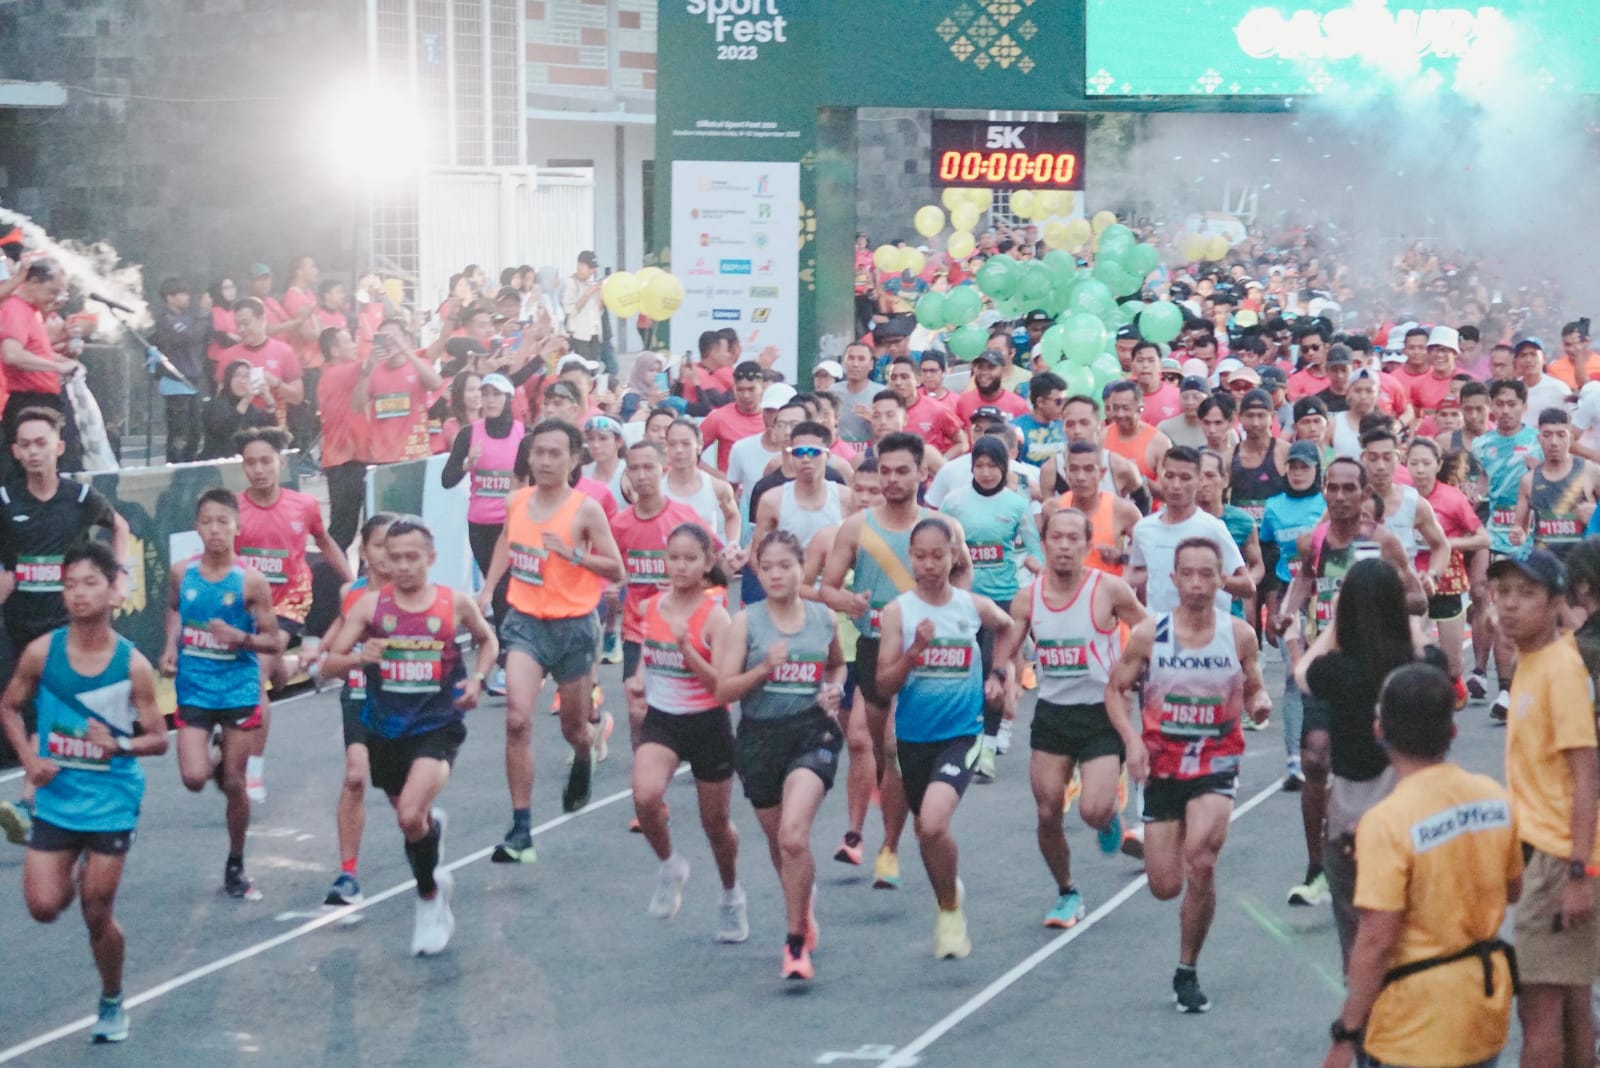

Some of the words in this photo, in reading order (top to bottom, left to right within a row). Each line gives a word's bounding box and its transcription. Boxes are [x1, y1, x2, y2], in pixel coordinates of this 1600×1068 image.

[716, 15, 787, 42] Fest
[717, 45, 758, 60] 2023
[986, 126, 1025, 149] 5K
[939, 151, 1076, 182] 00:00:00
[1158, 656, 1232, 669] INDONESIA
